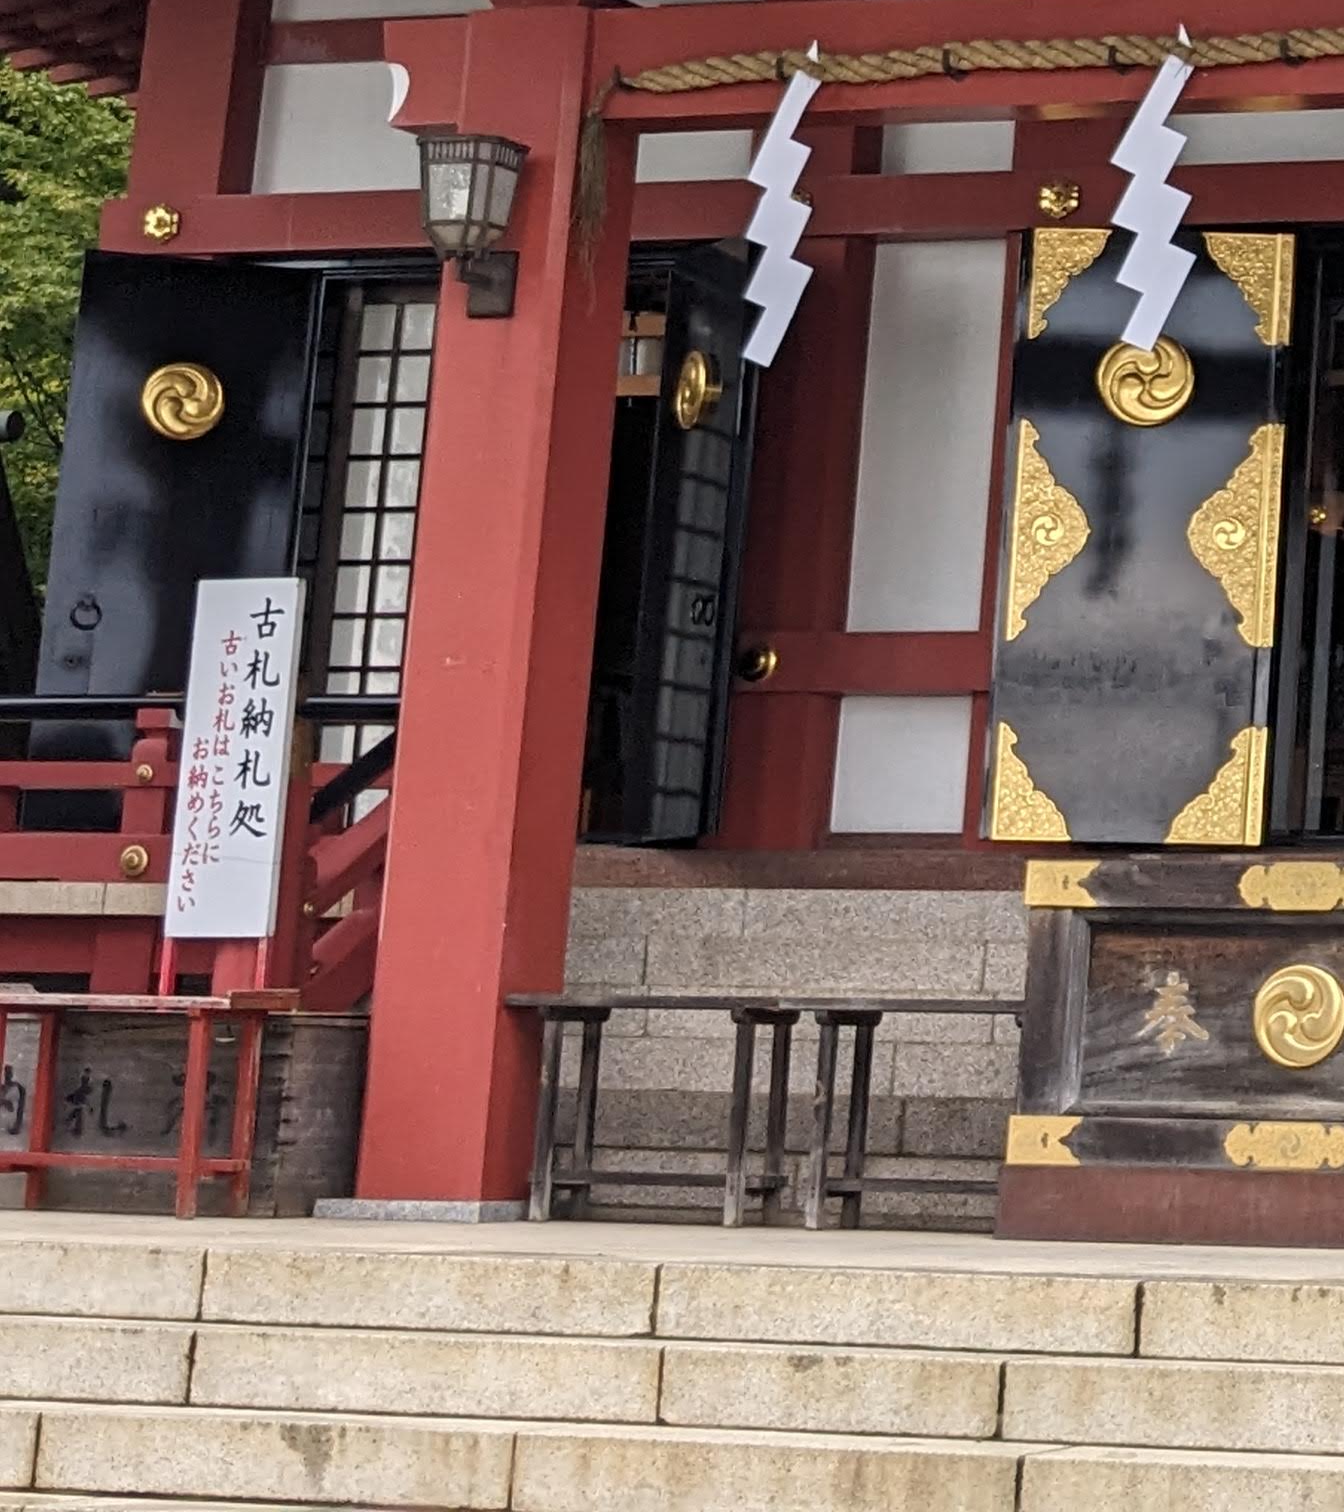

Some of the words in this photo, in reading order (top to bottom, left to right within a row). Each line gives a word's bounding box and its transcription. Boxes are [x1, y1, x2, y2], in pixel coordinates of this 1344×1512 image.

[177, 738, 210, 913] お納めください
[201, 630, 243, 864] 古いお札はこちらに
[229, 597, 285, 839] 古札納札処
